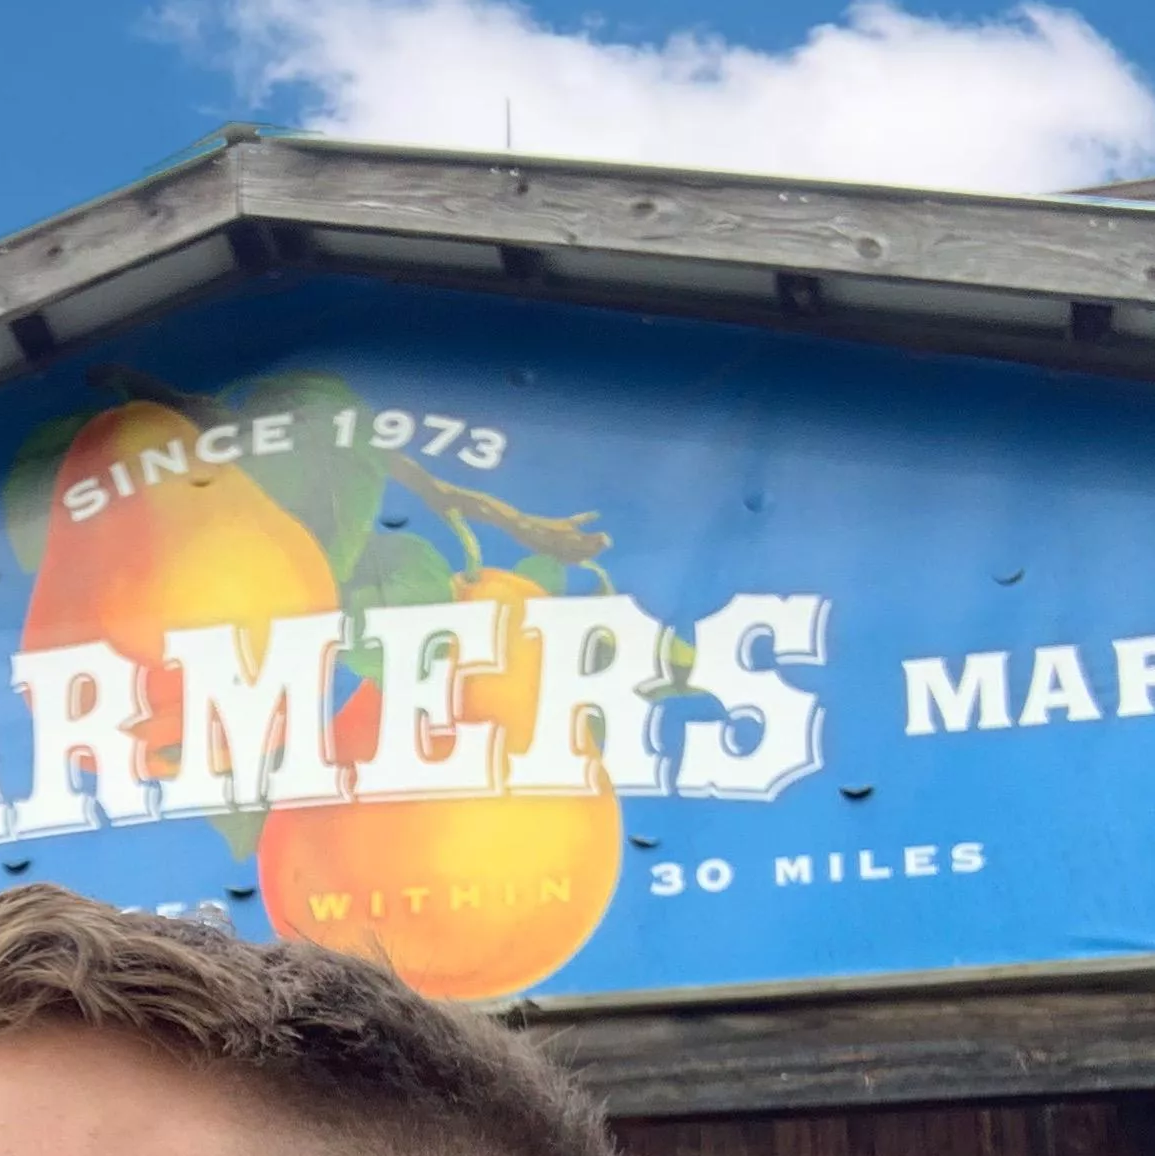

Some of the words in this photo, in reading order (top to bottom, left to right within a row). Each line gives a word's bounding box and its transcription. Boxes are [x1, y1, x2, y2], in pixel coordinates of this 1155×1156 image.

[62, 411, 294, 523] SINCE
[332, 407, 508, 470] 1973
[308, 876, 572, 923] WITHIN
[649, 857, 734, 897] 30
[773, 841, 988, 887] MILES
